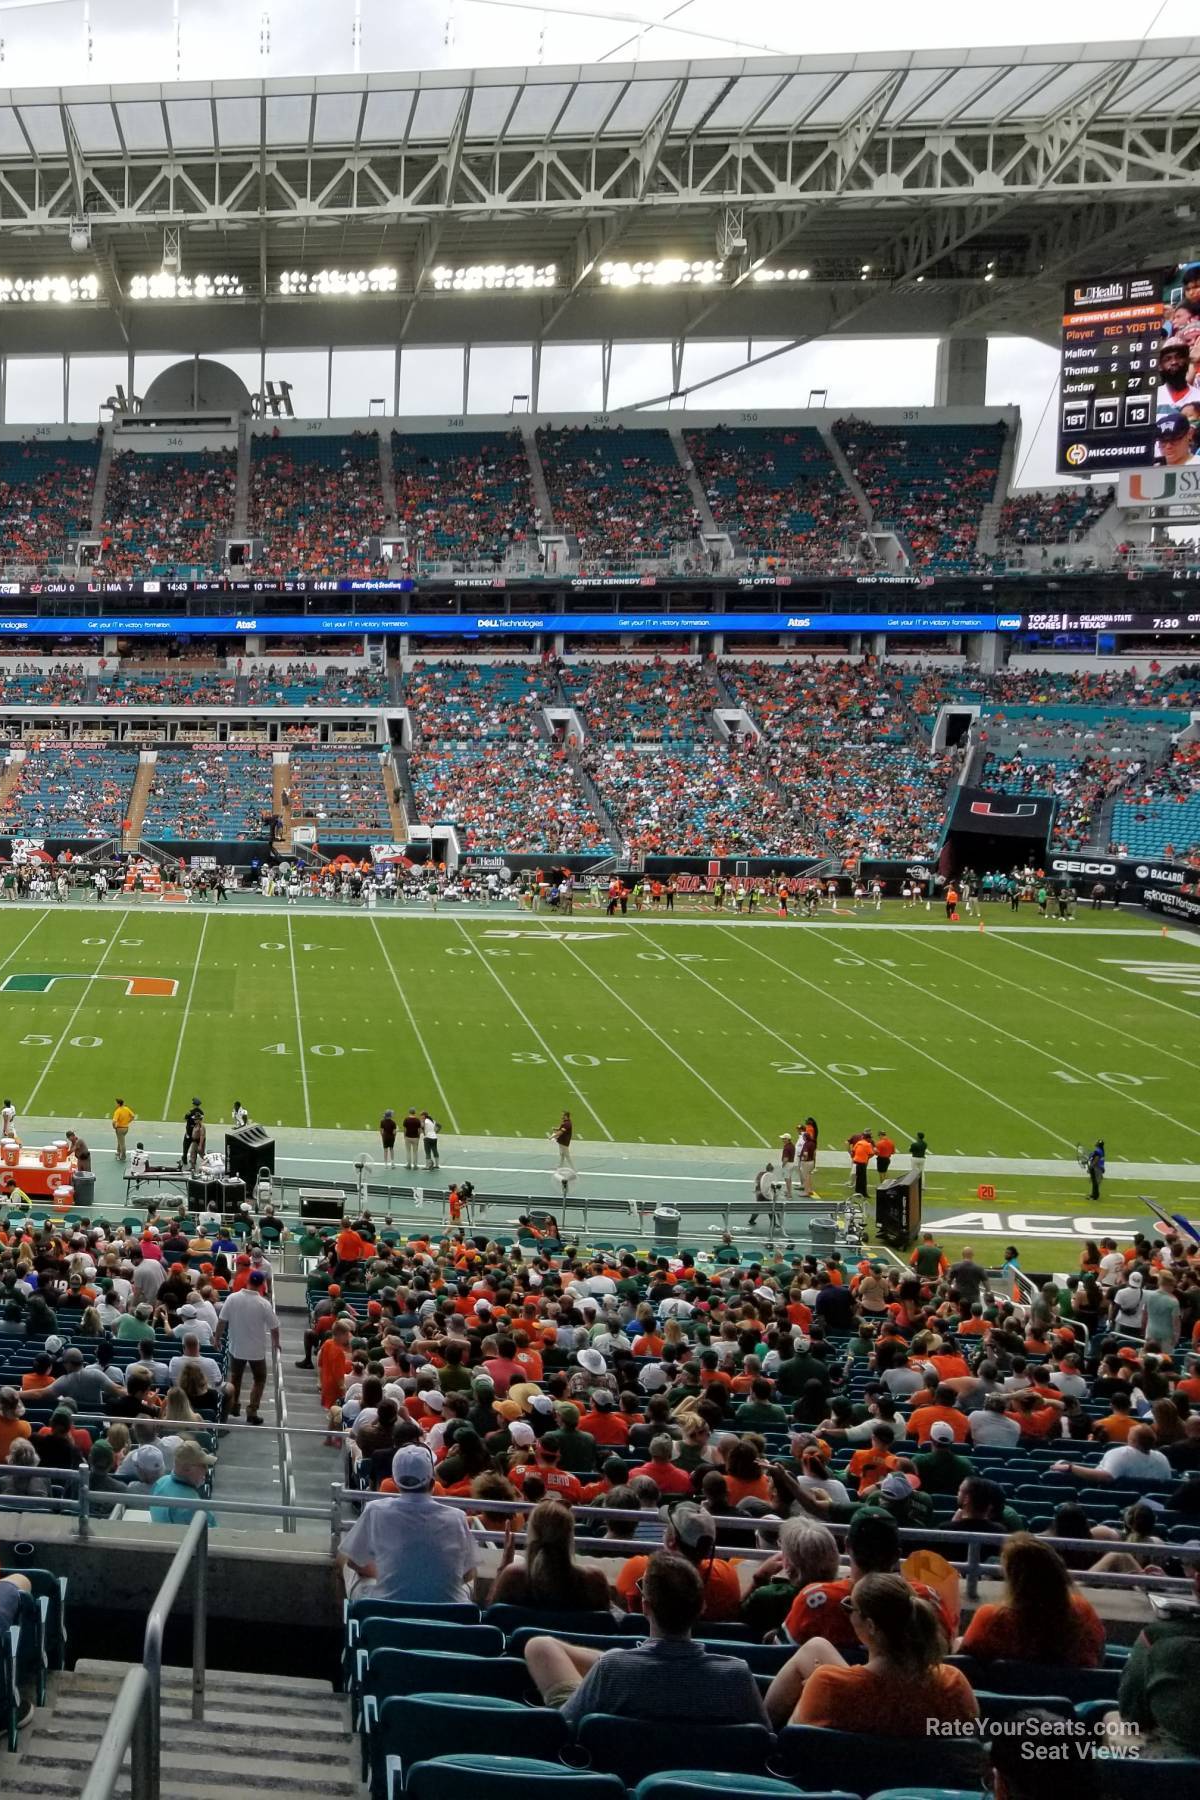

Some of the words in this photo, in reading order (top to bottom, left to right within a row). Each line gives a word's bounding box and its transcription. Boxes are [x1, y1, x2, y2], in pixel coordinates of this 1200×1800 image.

[1066, 330, 1095, 341] Player
[1104, 326, 1123, 336] REC
[1126, 323, 1147, 333] YDS
[1148, 321, 1161, 331] TD
[1064, 348, 1096, 359] Mallory
[1111, 345, 1119, 355] 2
[1150, 341, 1158, 350] 0
[1064, 365, 1099, 376] Thomas
[1111, 362, 1118, 372] 2
[1129, 360, 1140, 370] 10
[1149, 359, 1157, 368] 0
[1063, 382, 1094, 393] Jordan
[1111, 381, 1116, 389] 1
[1128, 377, 1141, 388] 27
[1148, 376, 1156, 386] 0
[1066, 414, 1085, 426] 1ST
[1100, 411, 1113, 423] 10
[1130, 408, 1145, 421] 13
[167, 438, 183, 446] 346
[1088, 445, 1147, 458] MICCOSUKEE
[167, 583, 187, 591] 14:43
[254, 583, 262, 591] 10
[454, 579, 468, 587] JIM
[469, 579, 493, 587] KELLY
[571, 578, 602, 586] CORTEZ
[603, 577, 641, 586] KENNEDY
[738, 577, 754, 585] JIM
[755, 577, 775, 585] OTTO
[857, 577, 878, 585] GINO
[47, 584, 66, 592] CMU
[69, 584, 75, 592] 0
[106, 584, 121, 592] MIA
[128, 584, 133, 592] 7
[1153, 619, 1180, 629] 7:30
[1052, 860, 1116, 875] GEICO
[19, 1034, 103, 1049] 50
[260, 1042, 345, 1057] 40
[511, 1052, 599, 1068] 30
[771, 1061, 871, 1077] 20
[1049, 1071, 1145, 1087] 10
[980, 1185, 995, 1199] 20
[922, 1212, 1140, 1240] ACC
